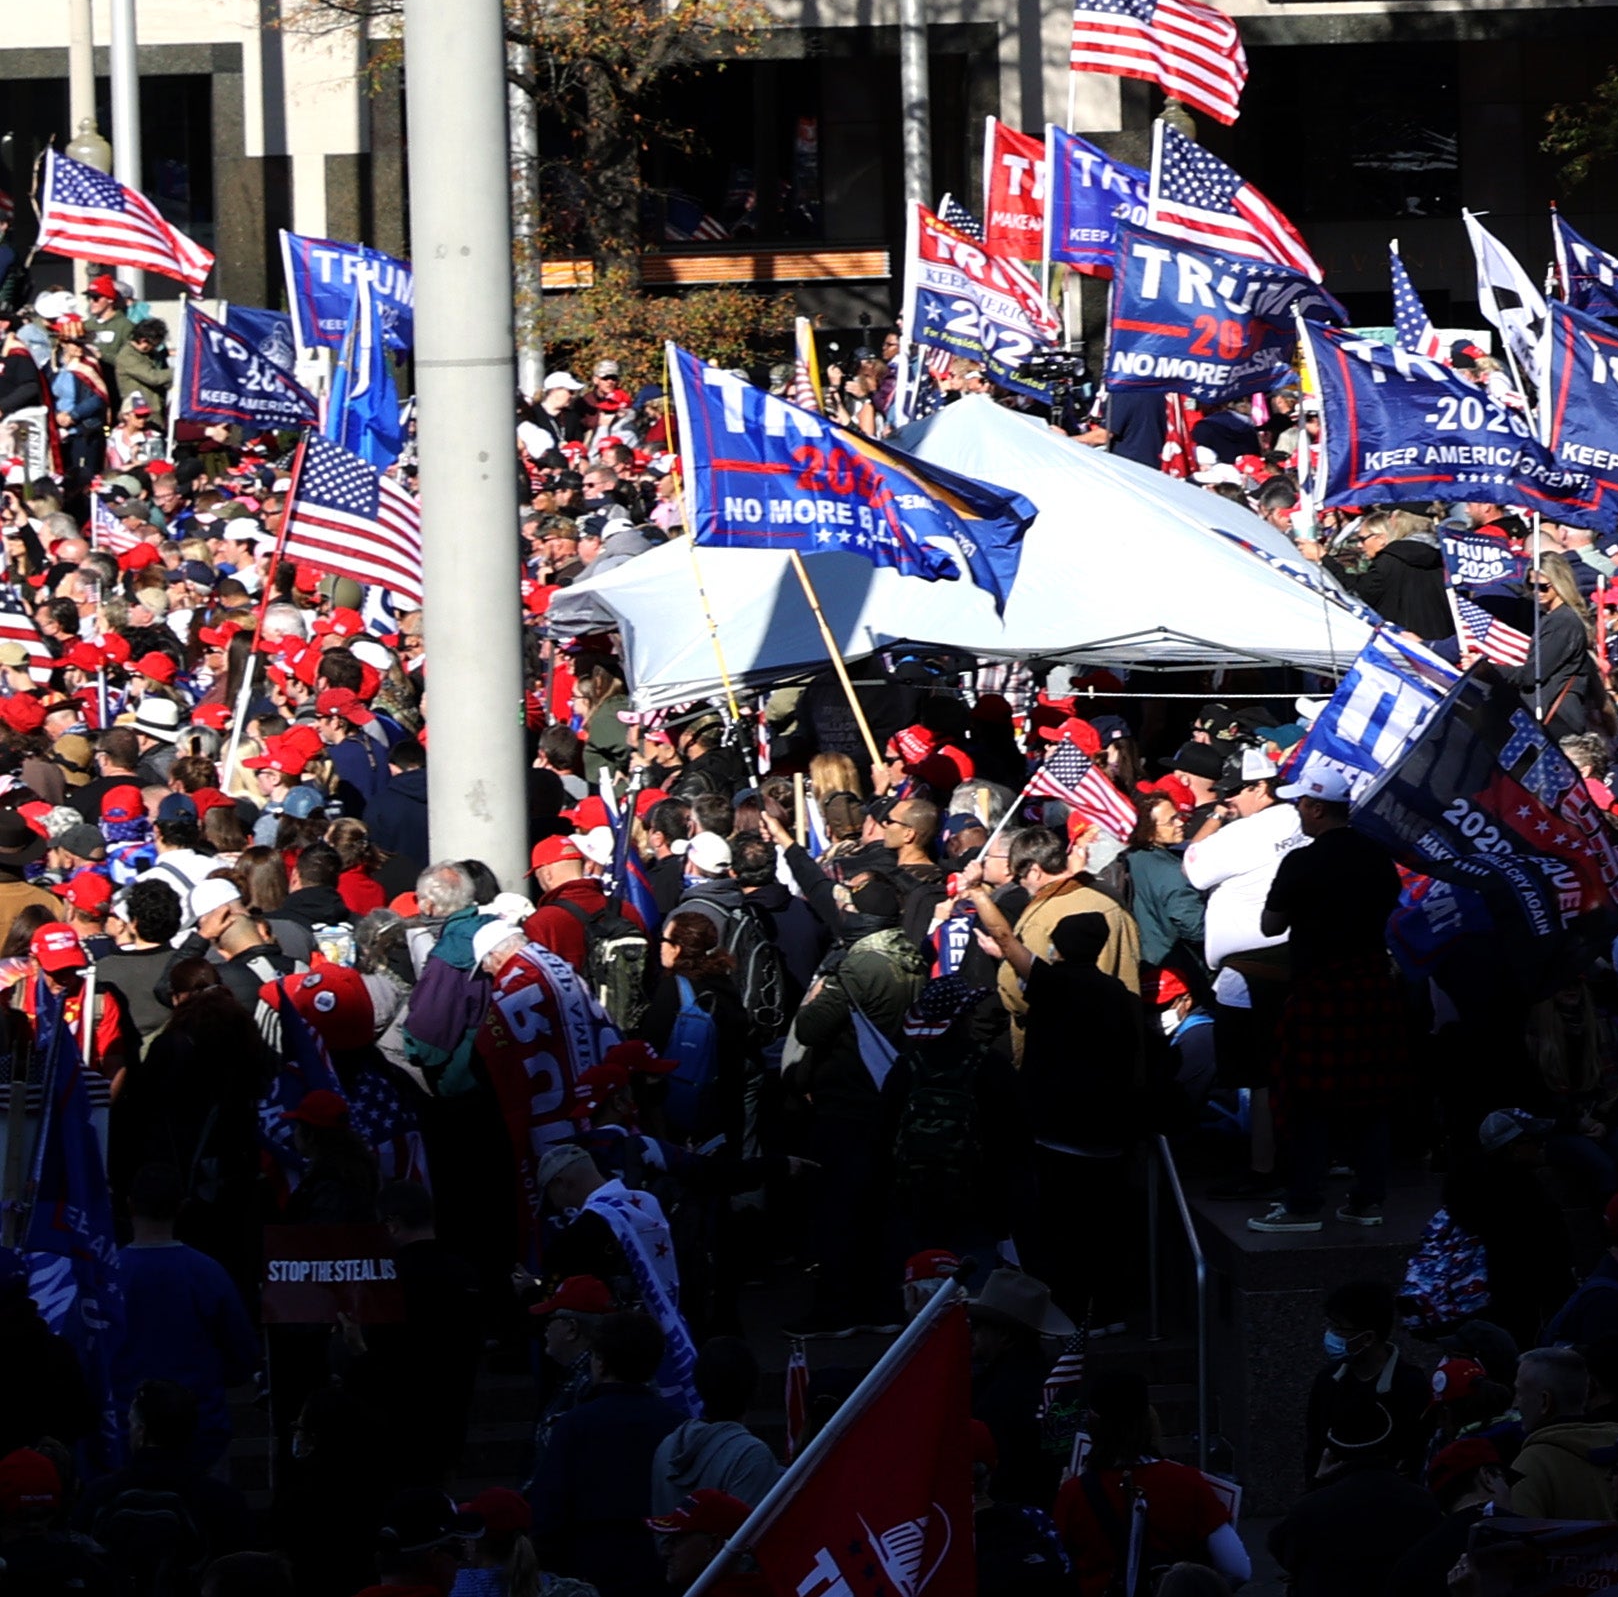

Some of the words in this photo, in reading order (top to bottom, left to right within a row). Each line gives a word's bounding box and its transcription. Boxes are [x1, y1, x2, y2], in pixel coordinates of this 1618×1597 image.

[1070, 228, 1111, 242] KEEP
[318, 318, 351, 332] KEE
[1112, 350, 1146, 375] NO
[1147, 356, 1228, 386] MORE
[200, 389, 237, 404] KEEP
[1364, 447, 1419, 470] KEEP
[724, 496, 762, 523] NO
[768, 499, 855, 526] MORE
[1457, 558, 1504, 580] 2020
[267, 1258, 399, 1283] STOPTHESTEAL.US
